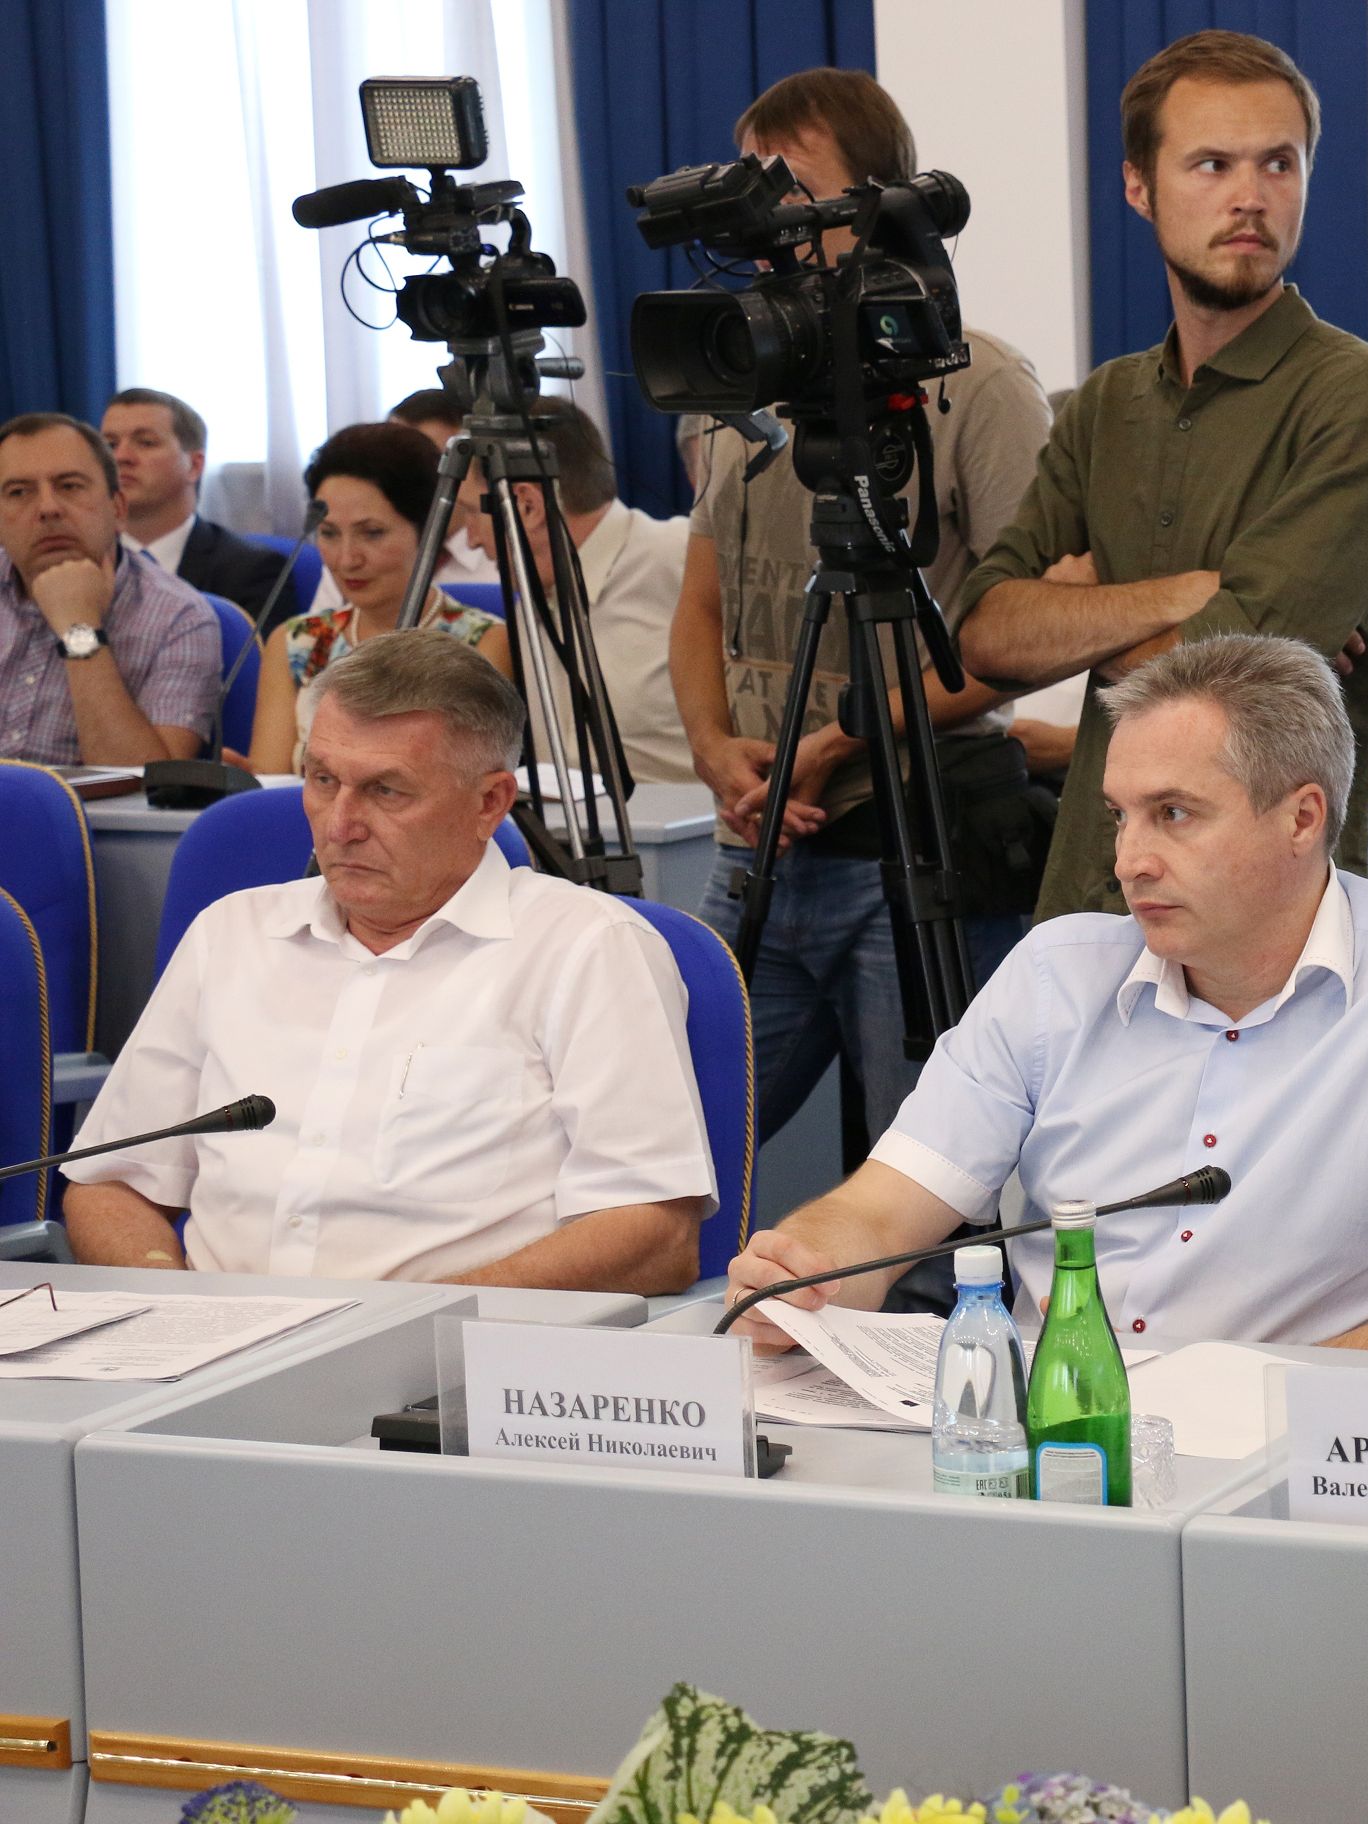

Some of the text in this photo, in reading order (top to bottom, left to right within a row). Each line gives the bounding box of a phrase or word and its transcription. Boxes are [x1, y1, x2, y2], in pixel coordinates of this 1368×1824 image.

[854, 475, 895, 552] Panasonic
[503, 1388, 706, 1428] НАЗАРЕНКО
[495, 1427, 718, 1462] Алексей Николаевич
